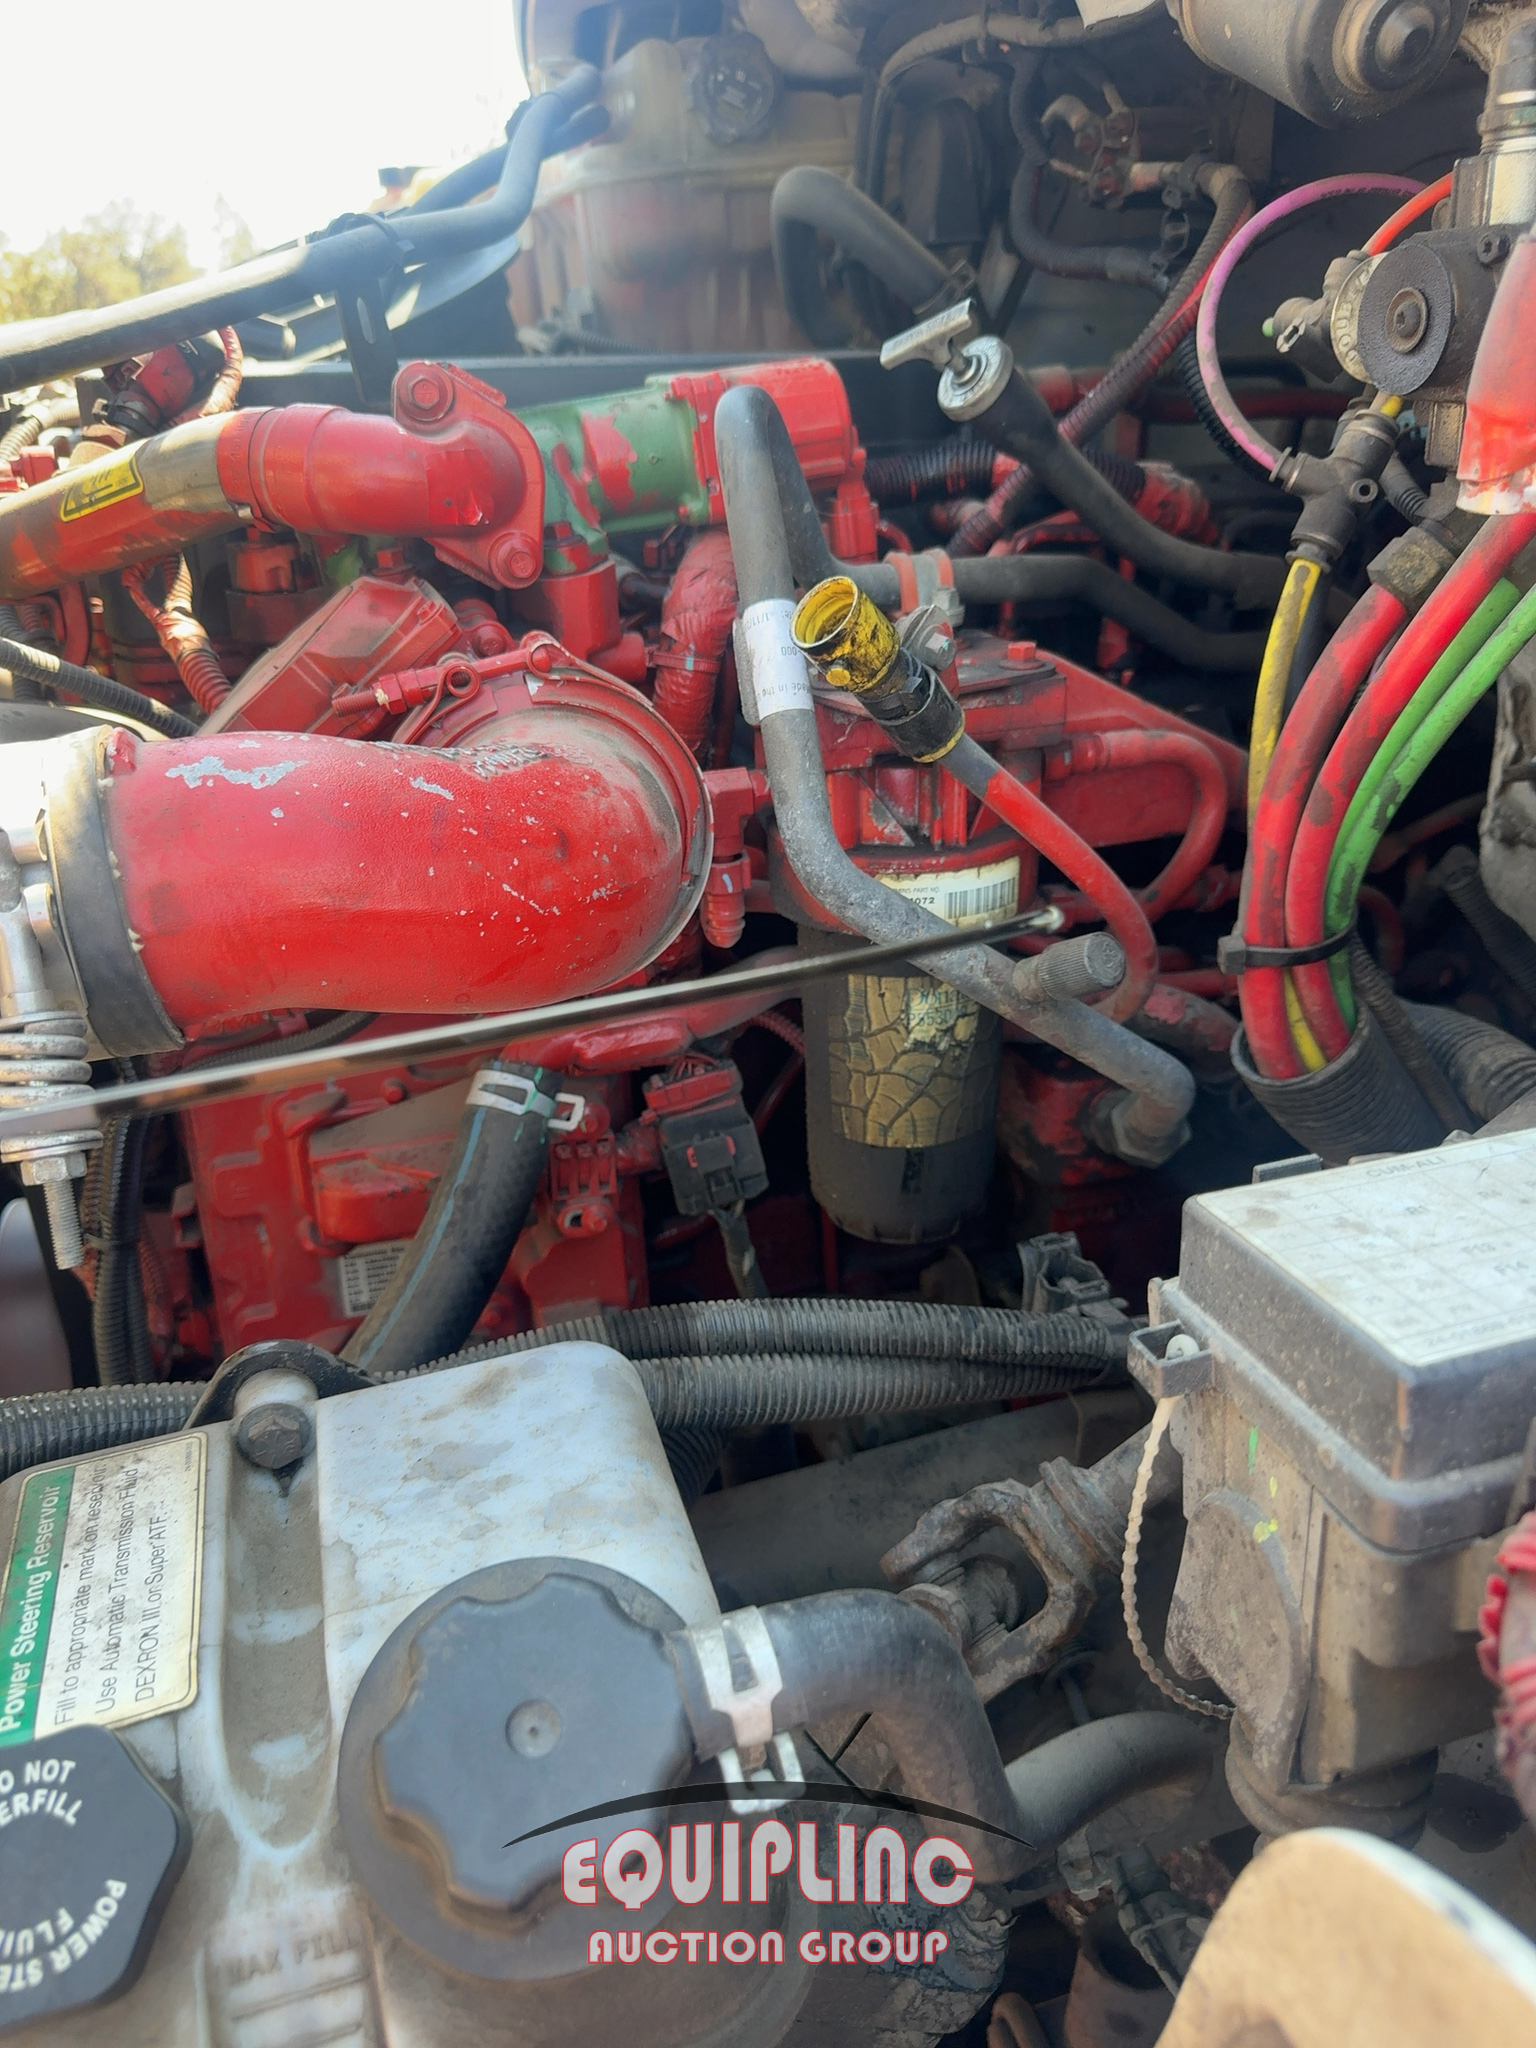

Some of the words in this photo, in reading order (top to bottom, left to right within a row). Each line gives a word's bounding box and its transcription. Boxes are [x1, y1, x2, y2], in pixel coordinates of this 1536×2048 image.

[119, 1467, 138, 1504] Fluid
[26, 1485, 61, 1571] Reservoir
[109, 1504, 134, 1593] Transmission
[79, 1544, 96, 1581] mark
[145, 1543, 170, 1588] Super
[11, 1571, 52, 1659] Steering
[148, 1584, 163, 1603] or
[66, 1584, 91, 1672] appropriate
[100, 1593, 126, 1671] Automatic
[135, 1623, 160, 1702] DEXRON
[0, 1660, 32, 1733] Power
[61, 1675, 79, 1696] to
[96, 1675, 117, 1714] Use
[55, 1695, 76, 1726] Fill
[0, 1770, 14, 1794] O
[24, 1759, 76, 1785] NOT
[0, 1788, 83, 1827] ERFILL
[0, 1907, 74, 1959] FLUI
[50, 1878, 127, 1974] POWER
[0, 1957, 44, 1993] STE
